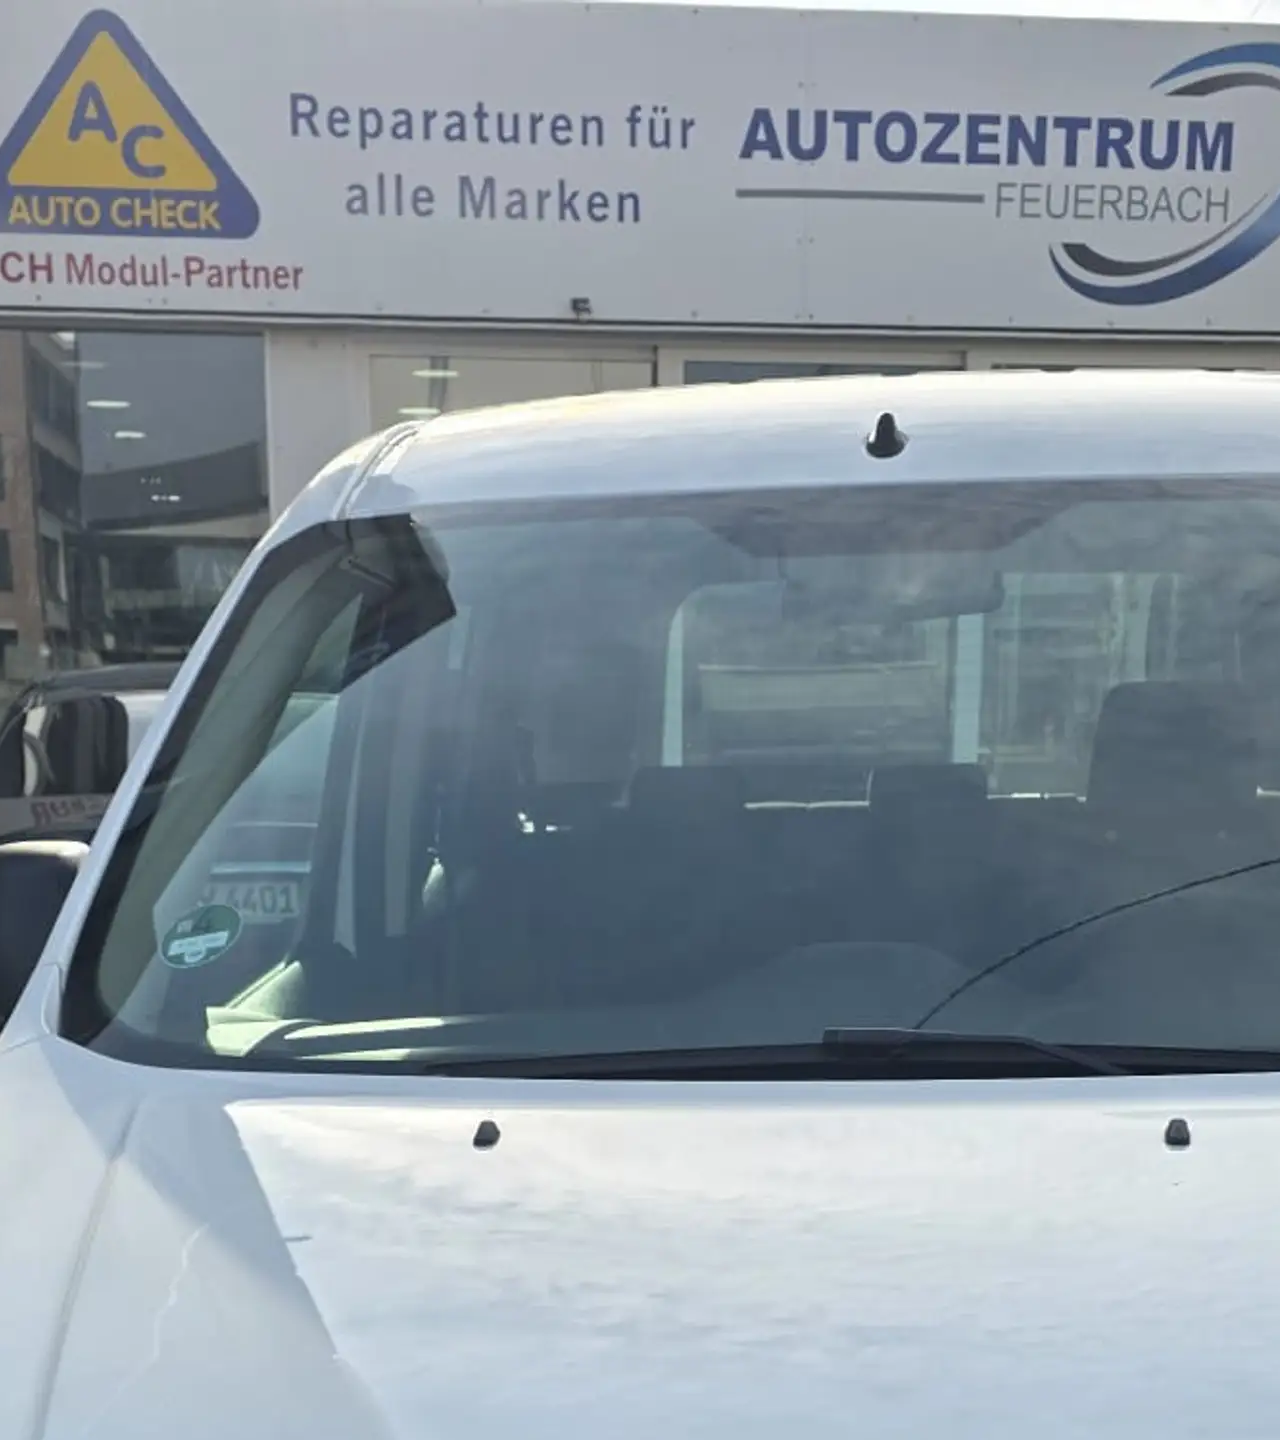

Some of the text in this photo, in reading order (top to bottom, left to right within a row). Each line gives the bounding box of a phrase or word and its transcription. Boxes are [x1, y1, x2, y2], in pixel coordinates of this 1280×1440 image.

[288, 92, 696, 149] Reparaturen für
[739, 107, 1235, 172] AUTOZENTRUM
[8, 196, 221, 230] AUTO CHECK
[345, 172, 641, 223] alle Marken
[995, 182, 1231, 224] FEUERBACH
[66, 252, 304, 290] Modul-Partner
